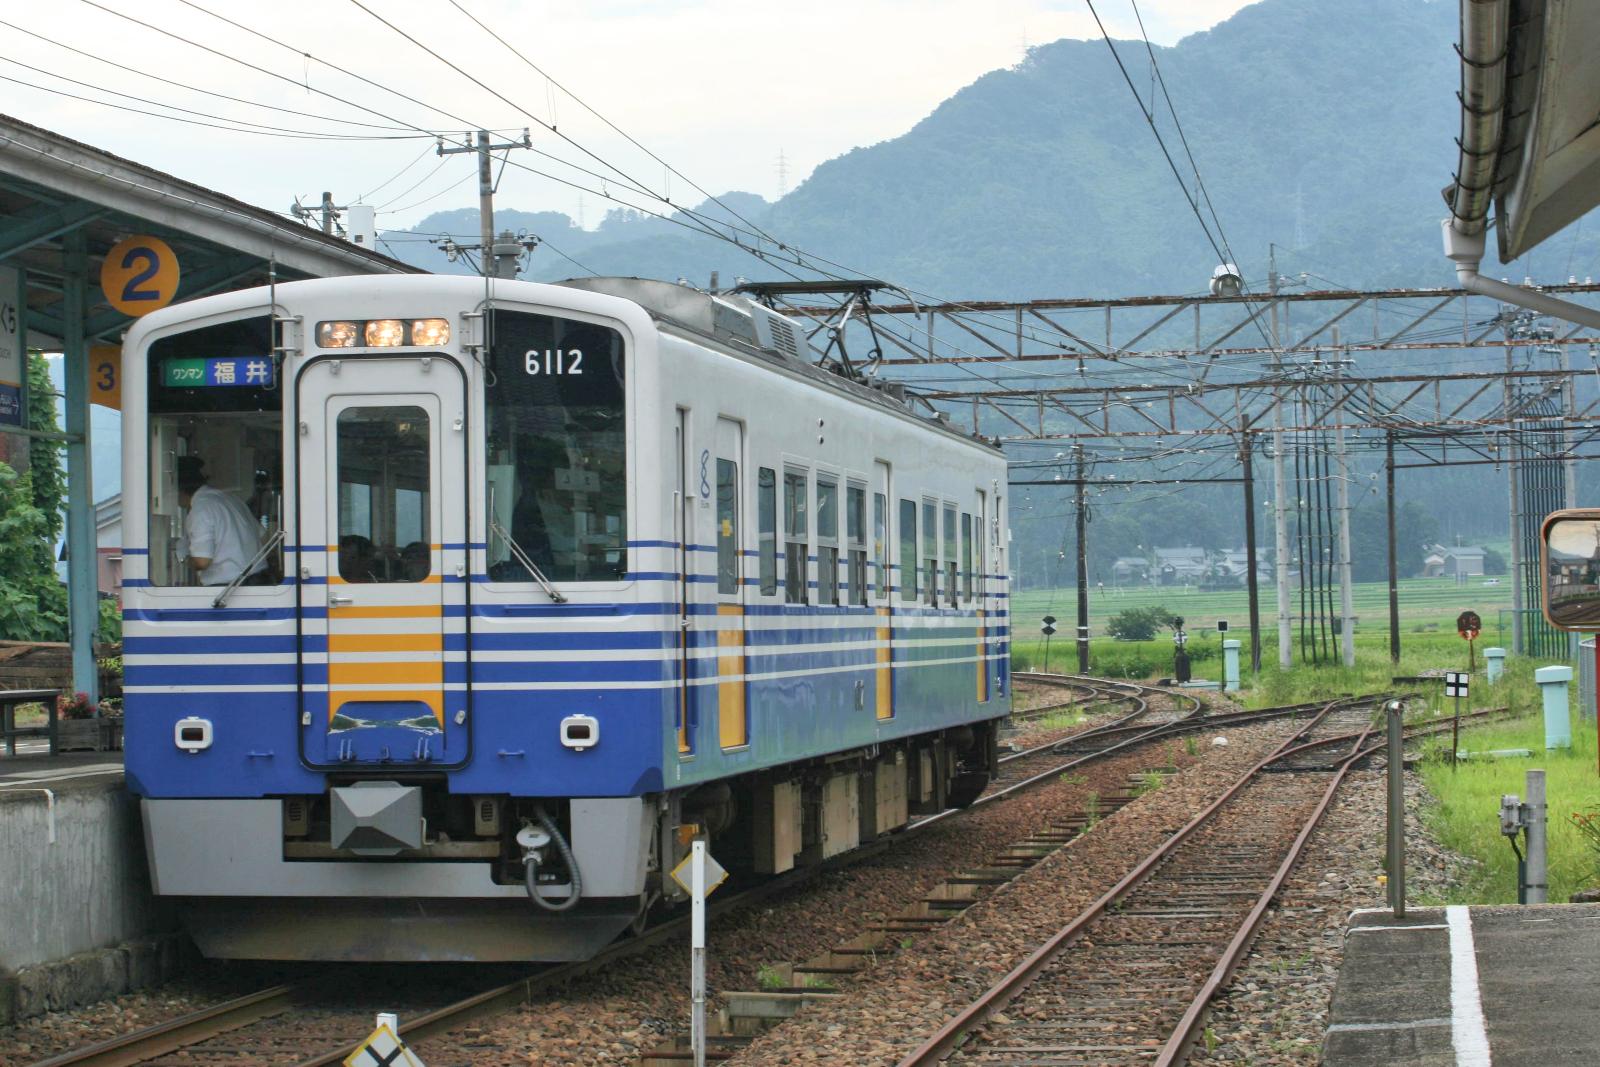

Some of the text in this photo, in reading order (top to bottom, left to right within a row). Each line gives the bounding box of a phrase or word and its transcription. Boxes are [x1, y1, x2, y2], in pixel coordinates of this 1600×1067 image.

[121, 246, 160, 301] 2
[173, 361, 267, 384] ワンマン 福井
[525, 349, 582, 375] 6112
[97, 363, 115, 391] 3
